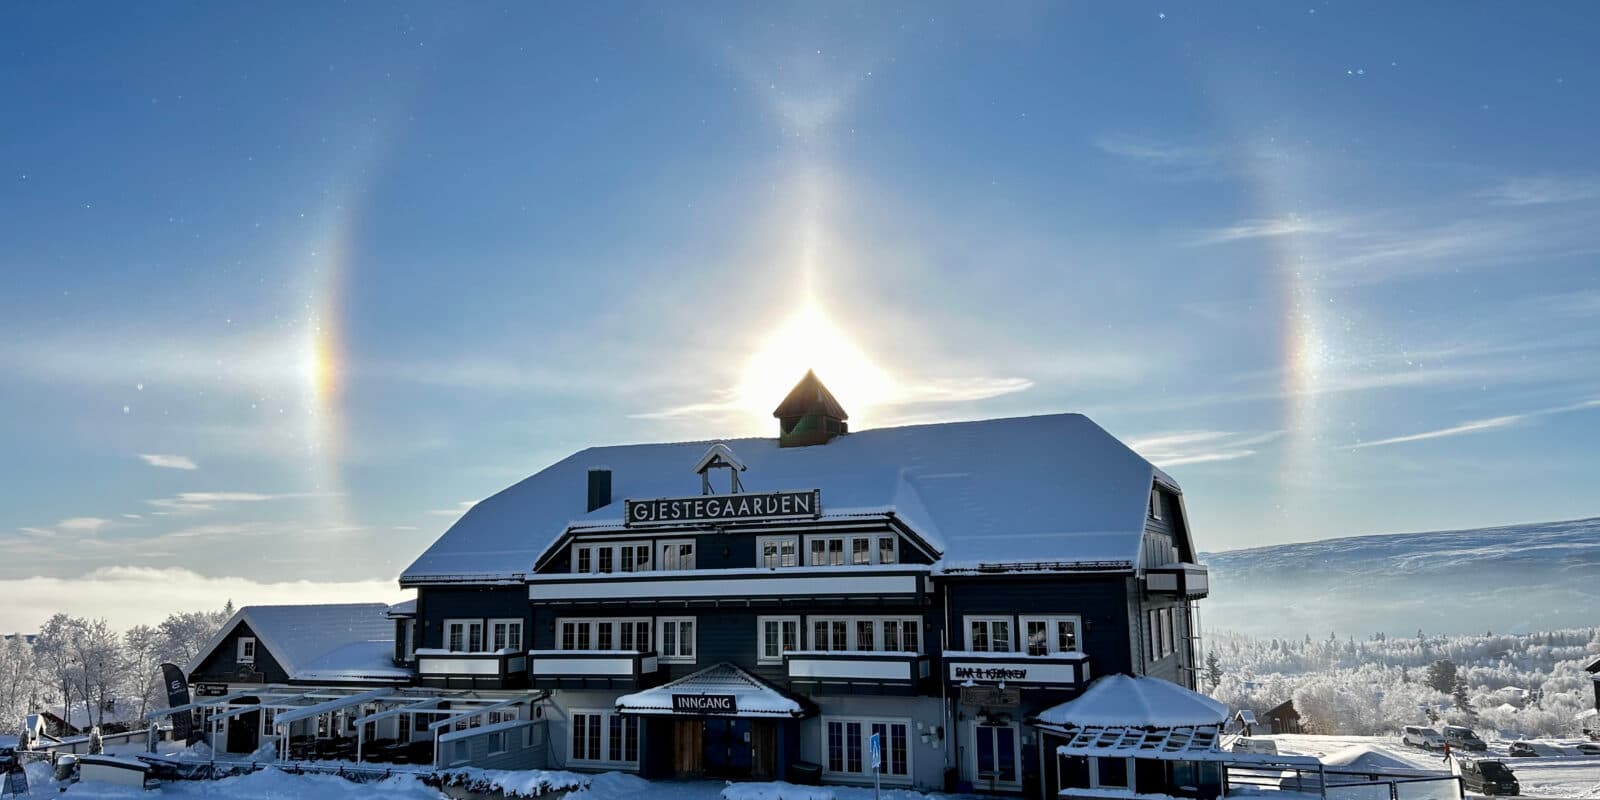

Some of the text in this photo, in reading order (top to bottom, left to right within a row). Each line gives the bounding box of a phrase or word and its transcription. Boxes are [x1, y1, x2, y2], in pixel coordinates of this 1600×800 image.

[633, 494, 809, 521] GJESTEGAARDEN
[955, 667, 974, 678] BAR
[678, 697, 730, 709] INNGANG
